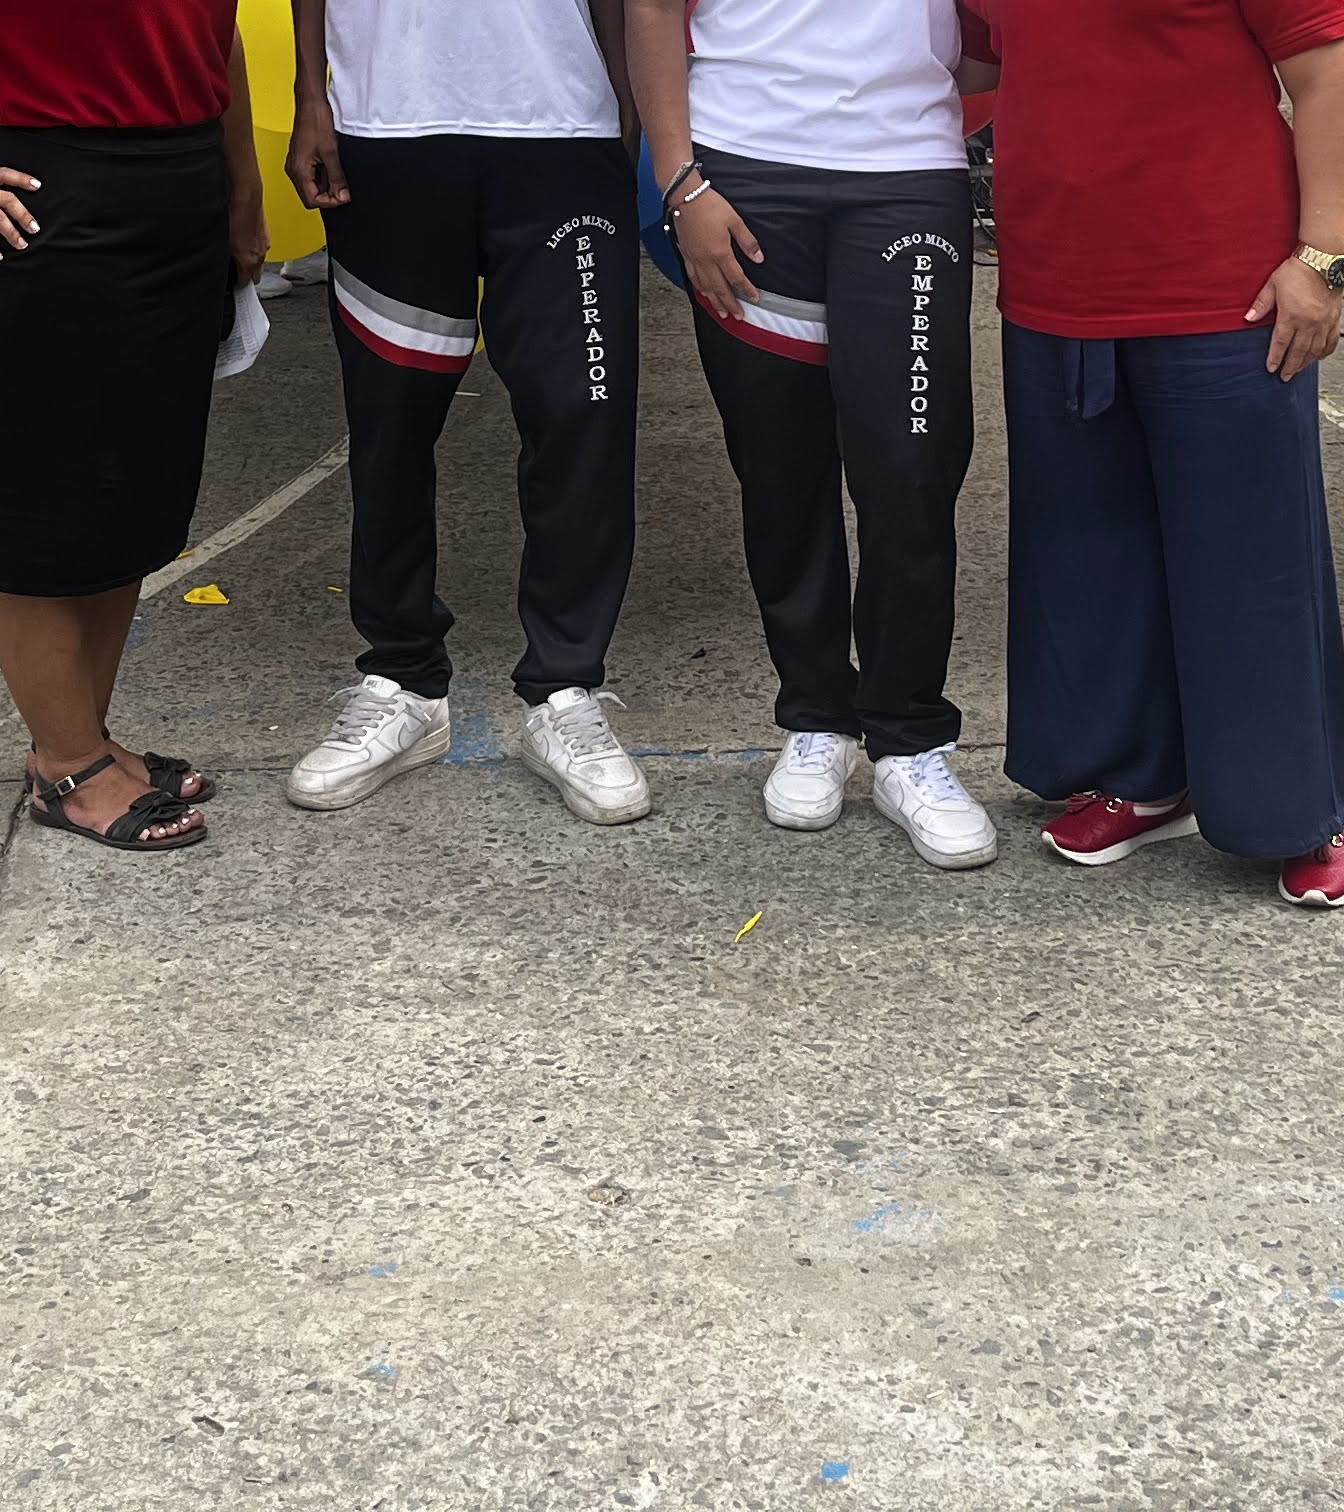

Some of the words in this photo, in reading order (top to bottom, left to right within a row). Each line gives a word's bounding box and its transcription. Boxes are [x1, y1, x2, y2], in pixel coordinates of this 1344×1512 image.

[546, 217, 580, 249] LICEO
[581, 215, 616, 235] MIXTO
[881, 233, 922, 262] LICEO
[924, 232, 960, 263] MIXTO
[575, 235, 609, 401] EMPERADOR
[909, 255, 935, 434] EMPERADOR
